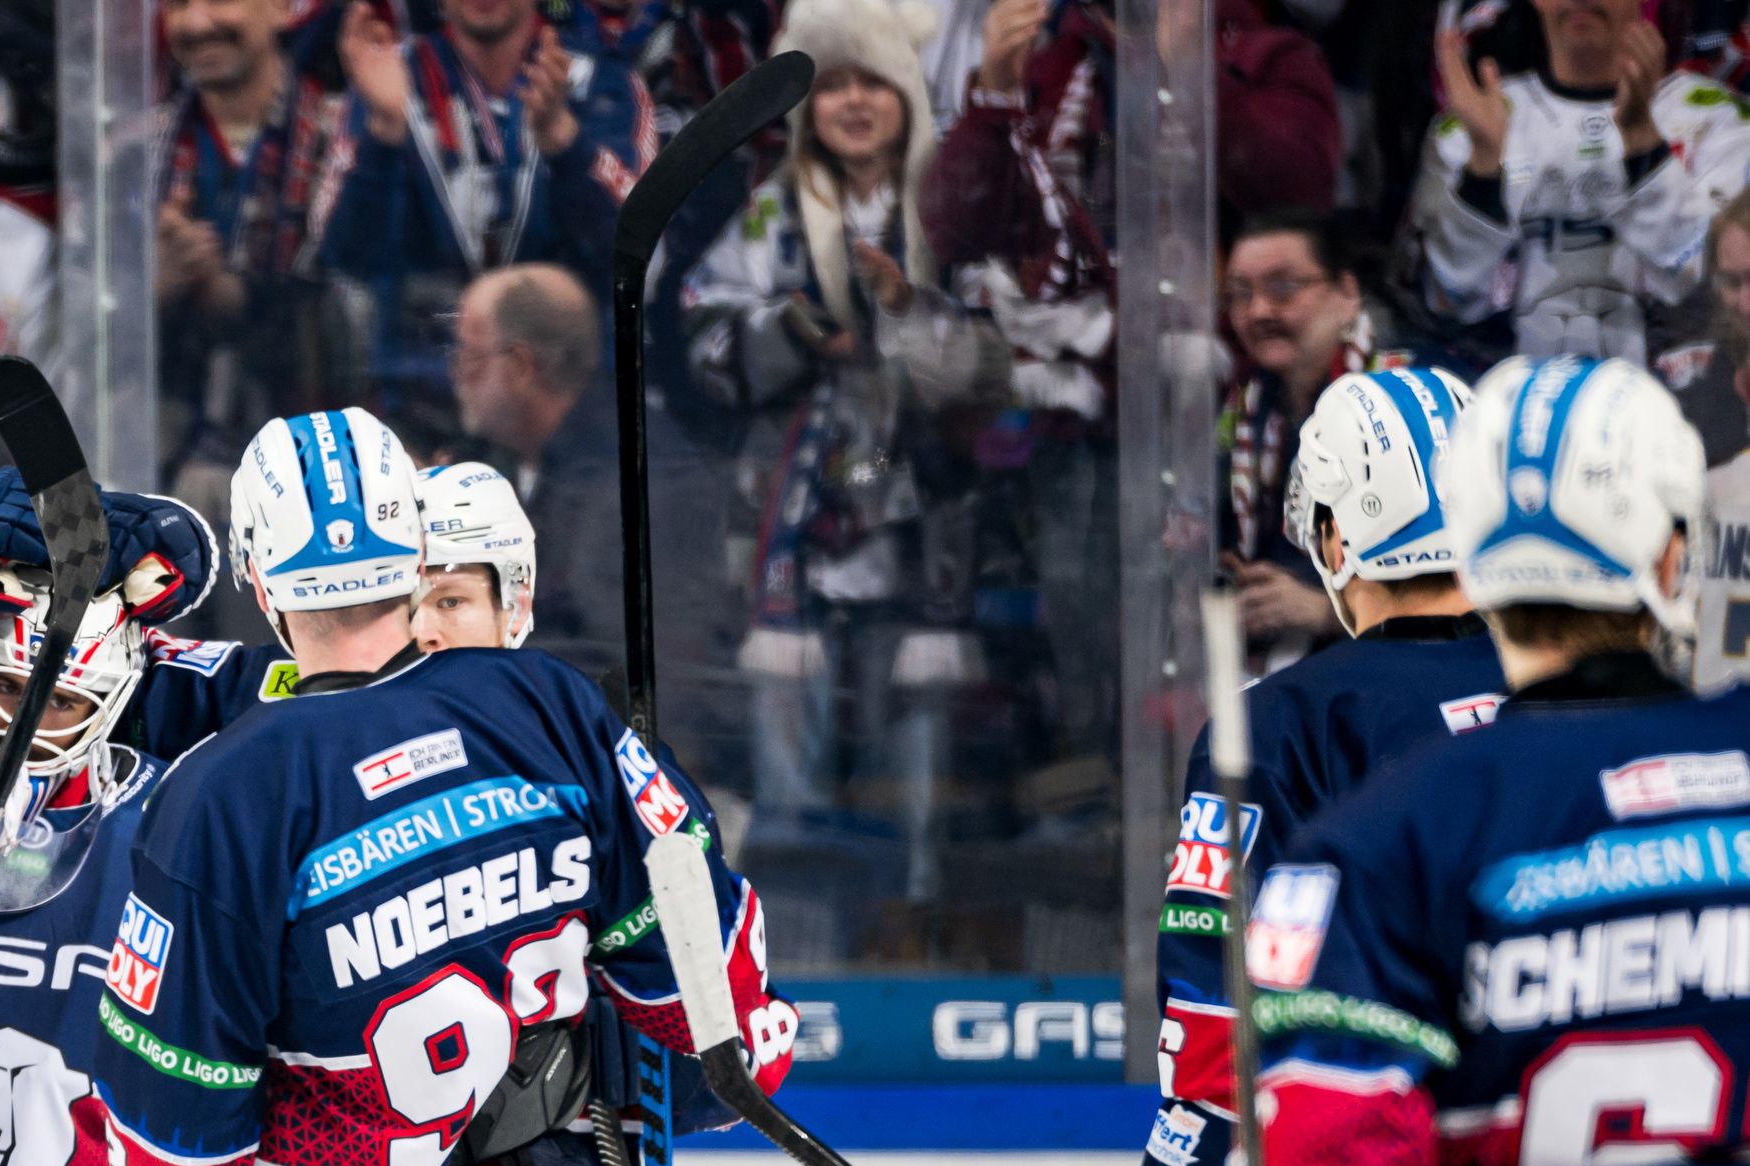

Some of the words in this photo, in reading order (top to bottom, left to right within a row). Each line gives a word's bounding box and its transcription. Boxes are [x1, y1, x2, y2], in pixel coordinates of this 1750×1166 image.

[1346, 383, 1391, 455] STADLER
[252, 434, 284, 499] TADLER
[310, 412, 347, 505] STADLER
[378, 501, 400, 522] 92
[484, 537, 523, 550] STADLER
[293, 571, 404, 598] STADLER
[1381, 549, 1454, 567] STAD
[118, 898, 167, 965] QUI
[325, 835, 592, 990] NOEBELS
[626, 902, 659, 938] LIG
[1166, 908, 1214, 931] LIGO
[107, 941, 160, 1004] OLY
[1460, 906, 1750, 1033] SCHEMI
[108, 1009, 136, 1043] LIGO
[138, 1032, 178, 1069] LIGO
[182, 1056, 229, 1086] LIGO
[232, 1066, 263, 1084] LIG
